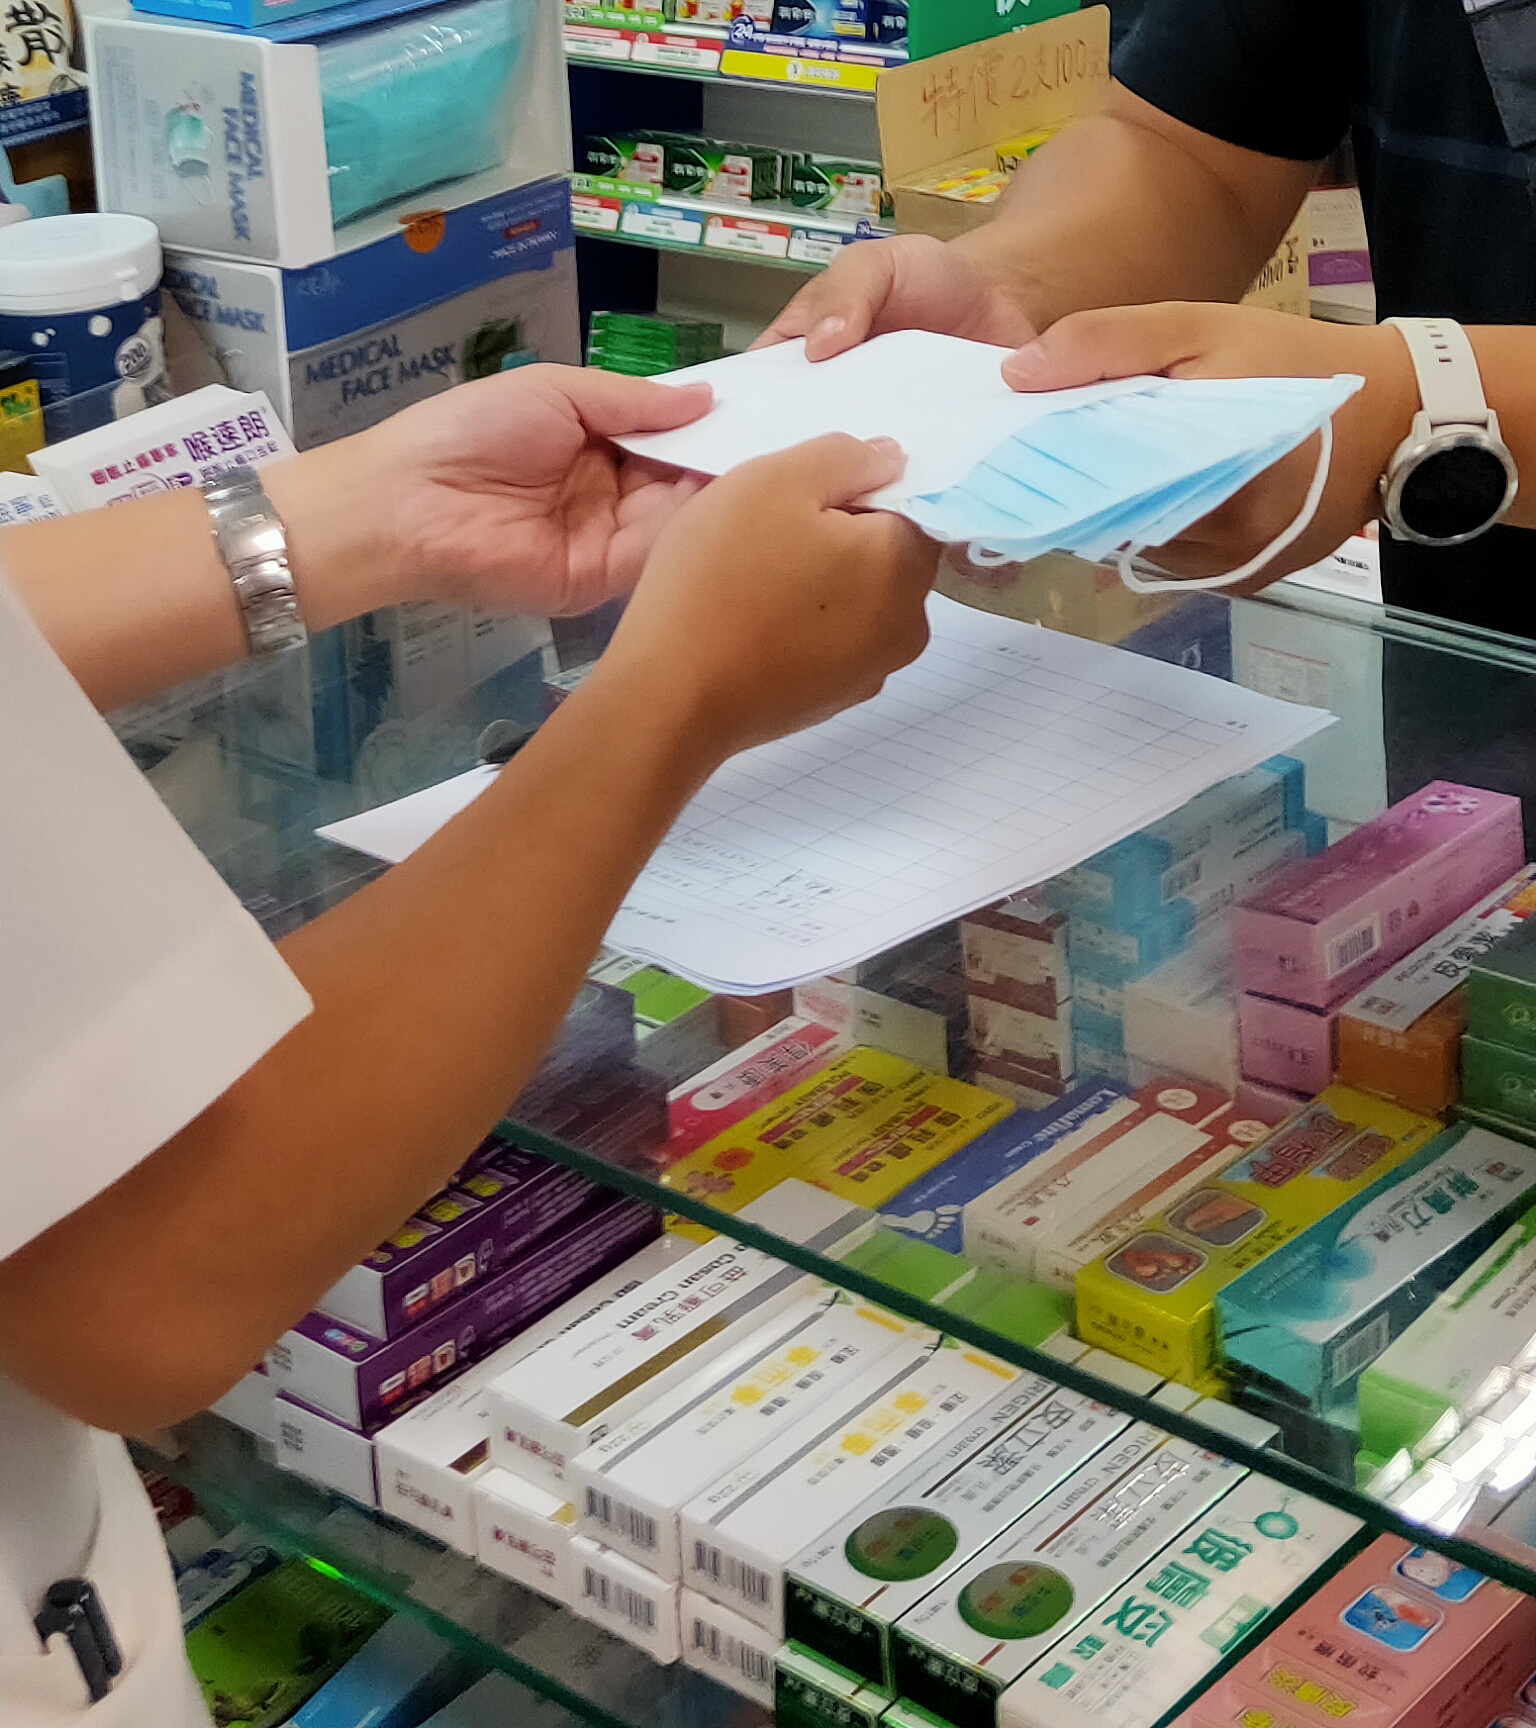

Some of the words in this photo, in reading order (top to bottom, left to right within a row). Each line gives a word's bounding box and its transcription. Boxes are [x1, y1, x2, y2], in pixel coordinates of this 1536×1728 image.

[304, 335, 402, 383] MEDICAL
[339, 370, 392, 403] FACE
[397, 343, 456, 383] MASK
